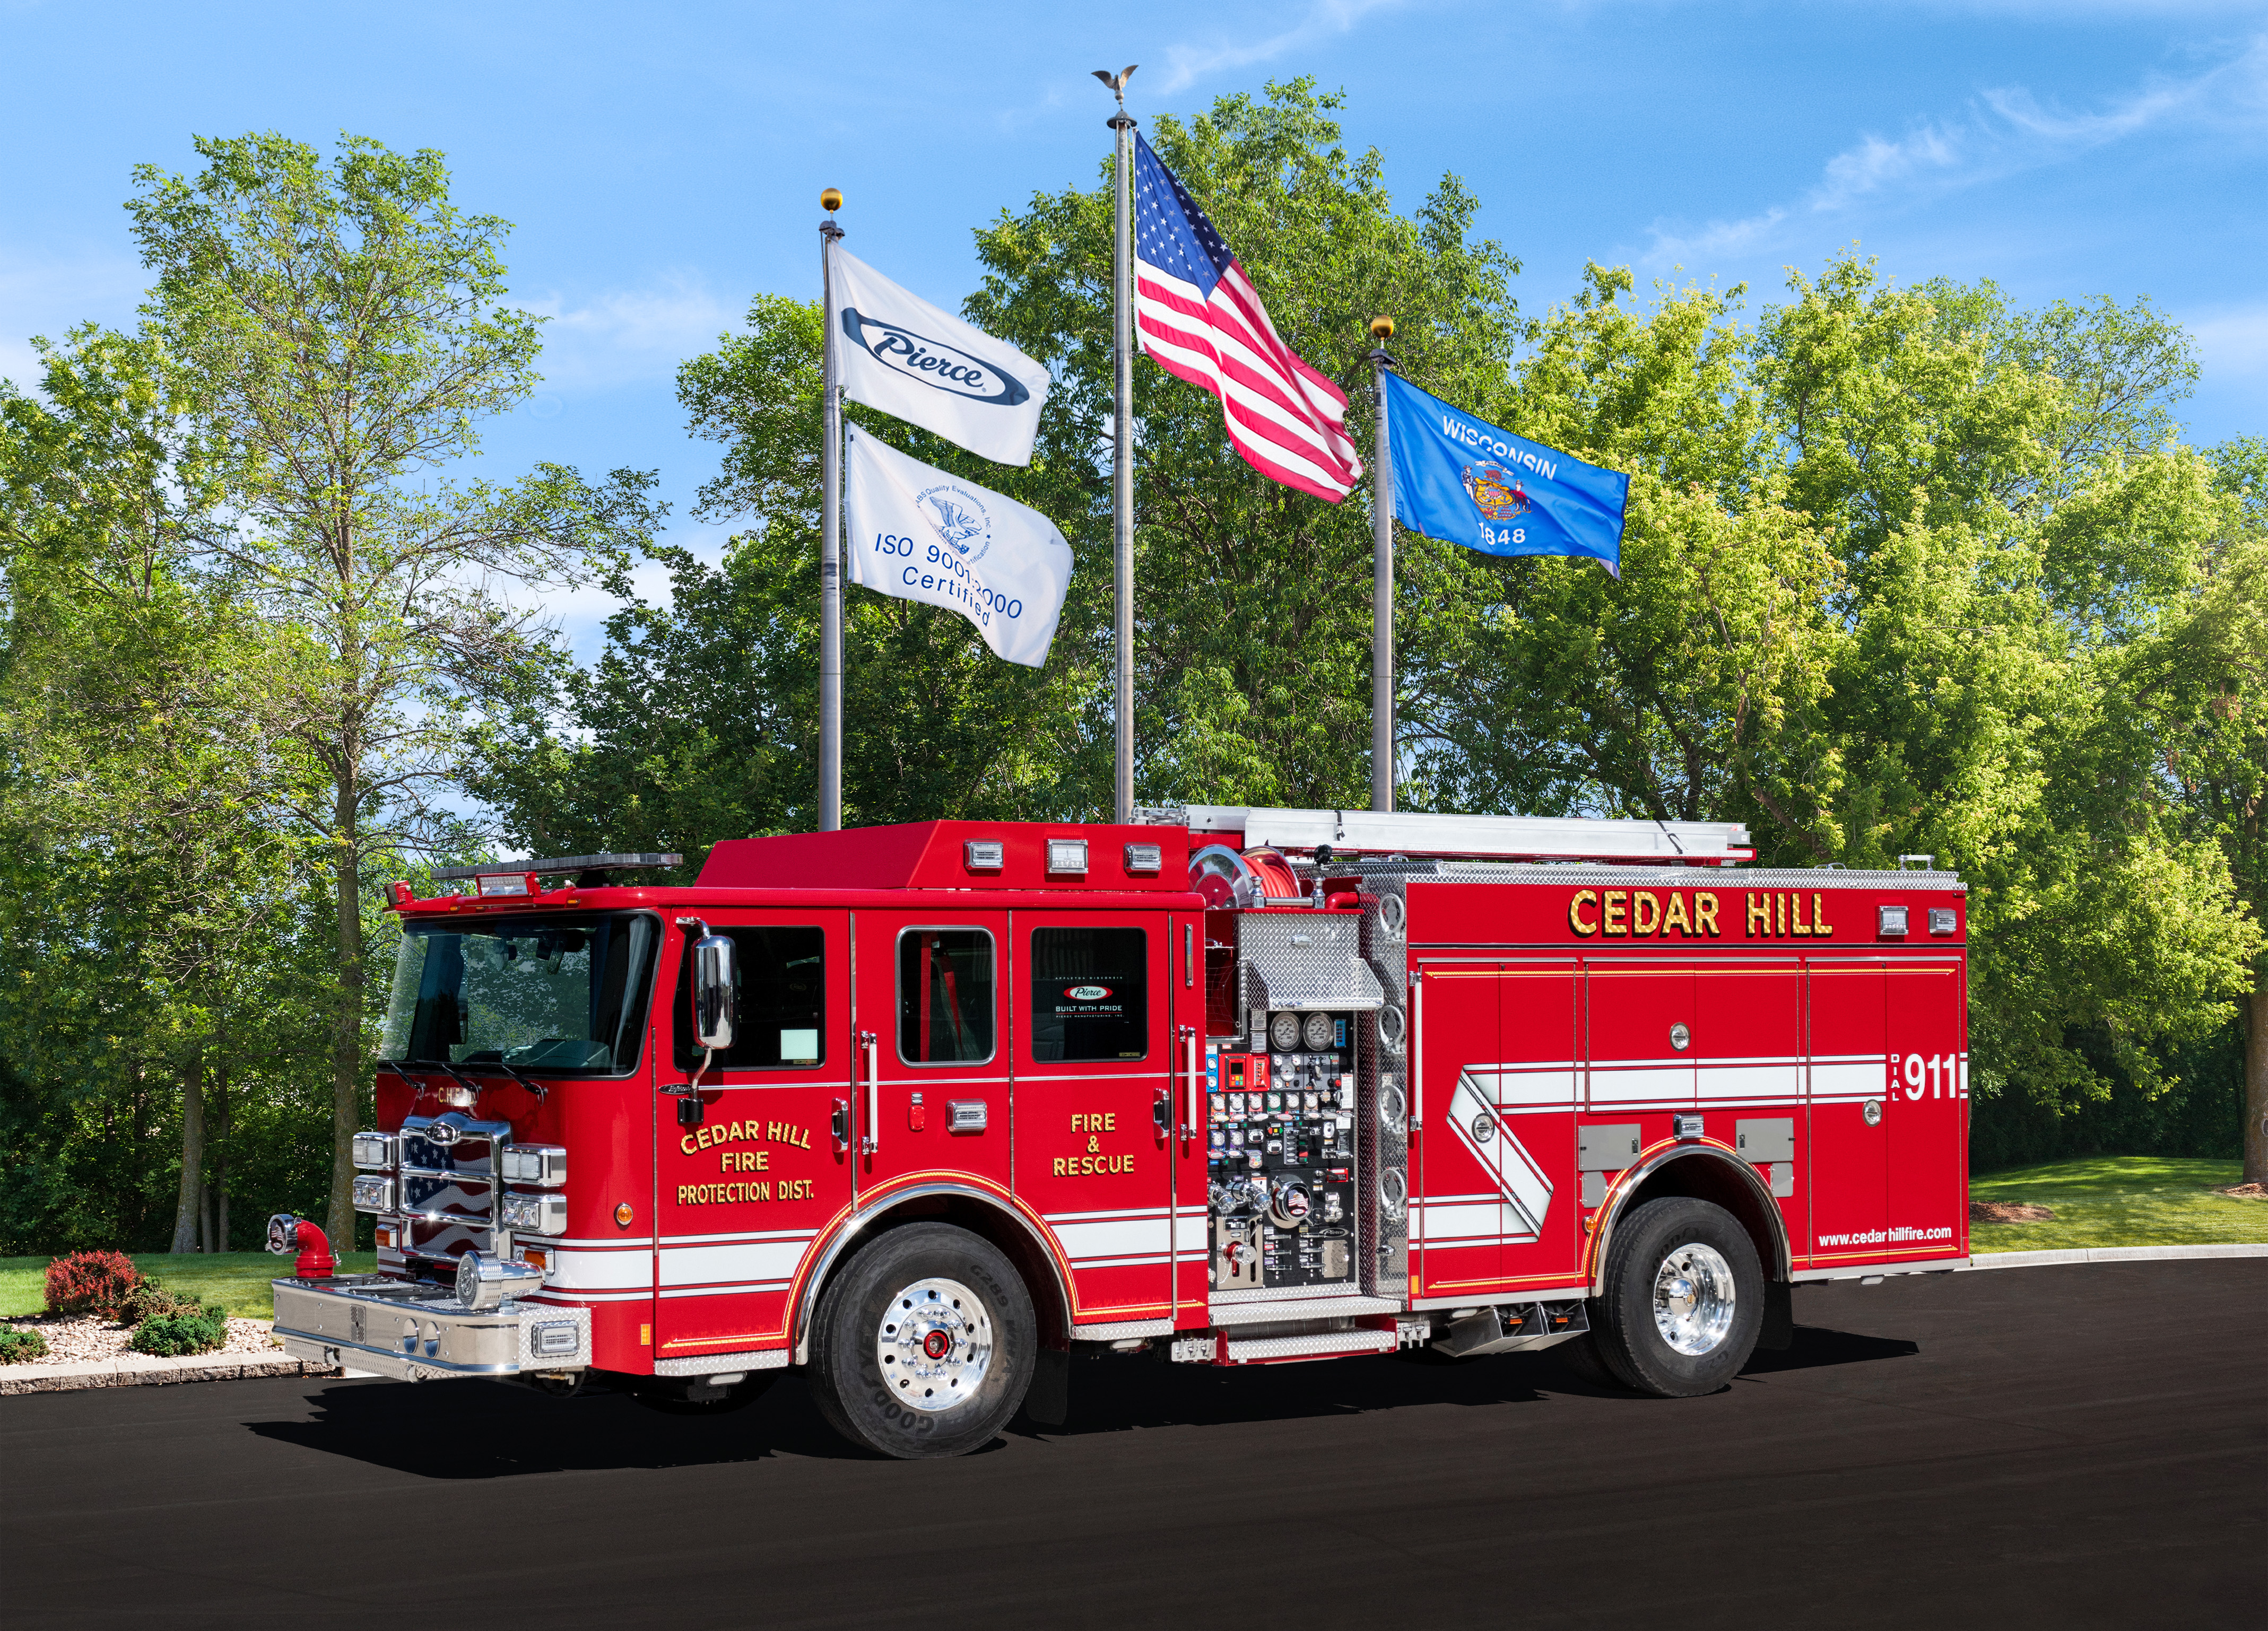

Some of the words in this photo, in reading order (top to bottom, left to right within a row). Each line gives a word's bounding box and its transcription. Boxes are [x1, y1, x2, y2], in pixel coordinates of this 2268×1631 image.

[874, 331, 984, 388] Pierce
[1443, 415, 1557, 481] WISCONSIN
[915, 491, 927, 505] ABS
[925, 485, 950, 495] Quality
[952, 485, 987, 516] Evaluations,
[875, 533, 914, 557] ISO
[1478, 522, 1526, 546] 1848
[902, 566, 990, 627] Certified
[1568, 889, 1721, 938] CEDAR
[1745, 891, 1833, 938] HILL
[1075, 987, 1102, 998] Pierce
[1890, 1053, 1900, 1102] DIAL
[1905, 1053, 1956, 1101] 911
[1071, 1113, 1116, 1133] FIRE
[680, 1120, 759, 1155] CEDAR
[766, 1120, 811, 1150] HILL
[1086, 1135, 1100, 1154] &
[720, 1151, 769, 1173] FIRE
[1053, 1154, 1134, 1177] RESCUE
[677, 1181, 770, 1206] PROTECTION
[778, 1179, 814, 1201] DIST.
[1819, 1226, 1952, 1246] www.cedarhillfire.com
